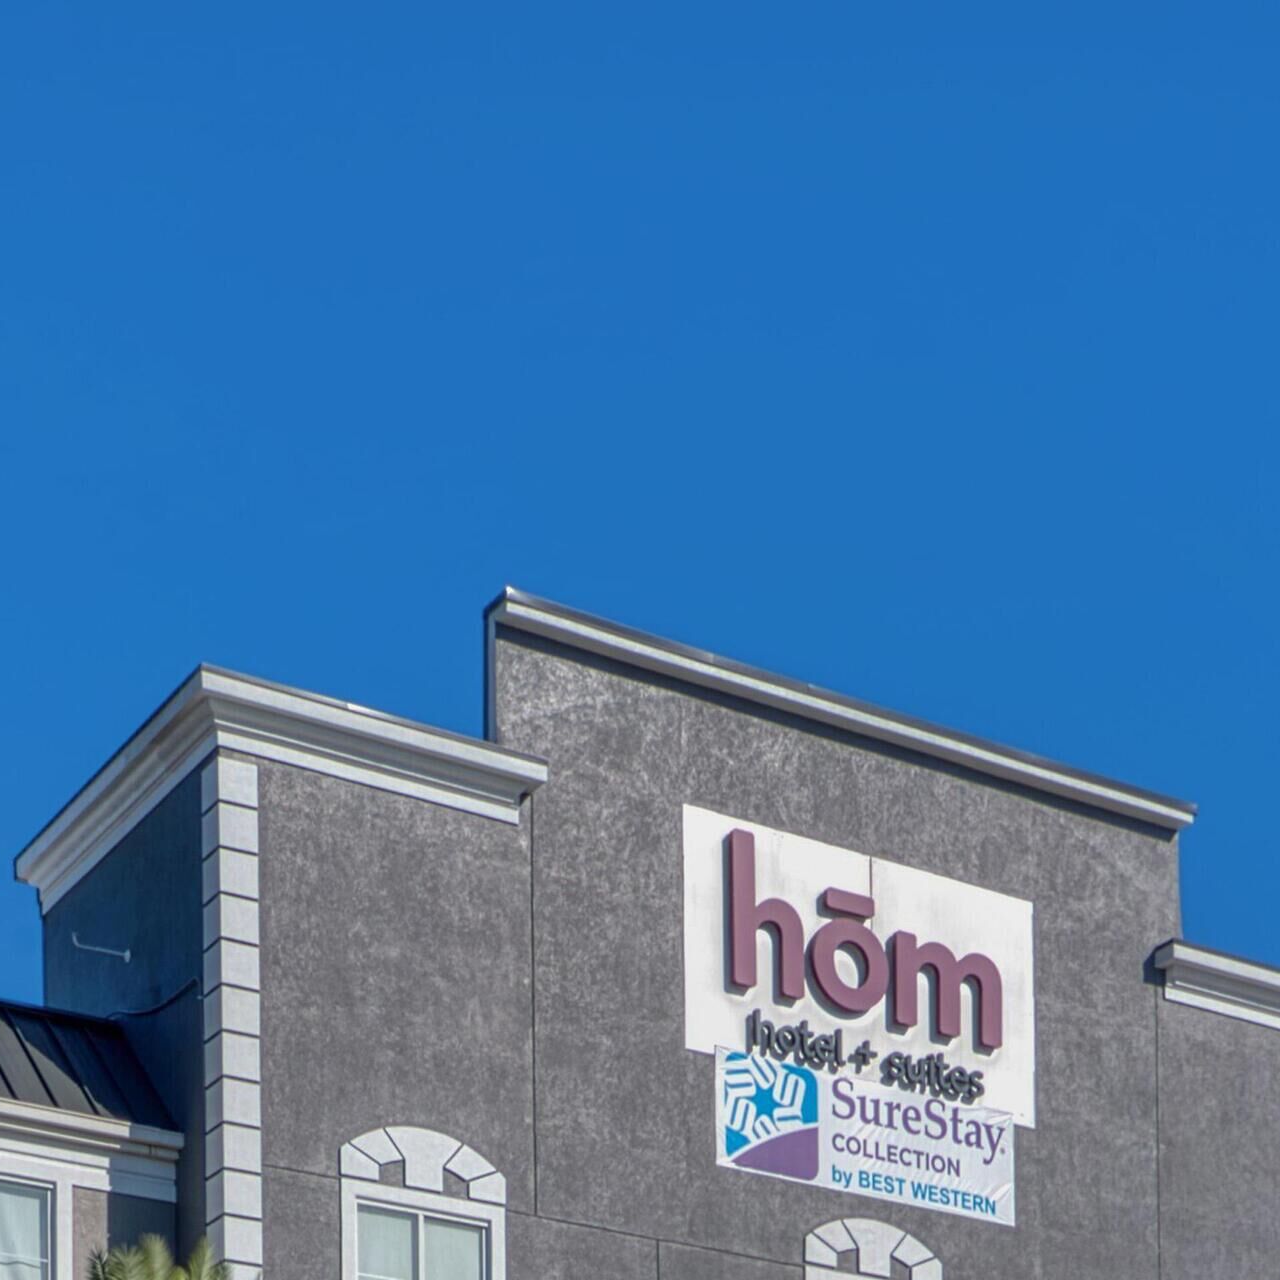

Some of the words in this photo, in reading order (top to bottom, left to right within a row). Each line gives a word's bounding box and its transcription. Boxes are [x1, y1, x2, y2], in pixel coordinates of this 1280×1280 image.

[724, 828, 1003, 1053] hōm
[747, 1008, 846, 1073] hotel
[848, 1040, 877, 1074] +
[881, 1052, 985, 1104] suites
[832, 1077, 1006, 1165] SureStay
[832, 1133, 961, 1177] COLLECTION
[832, 1164, 853, 1189] by
[858, 1170, 906, 1196] BEST
[911, 1181, 997, 1215] WESTERN
